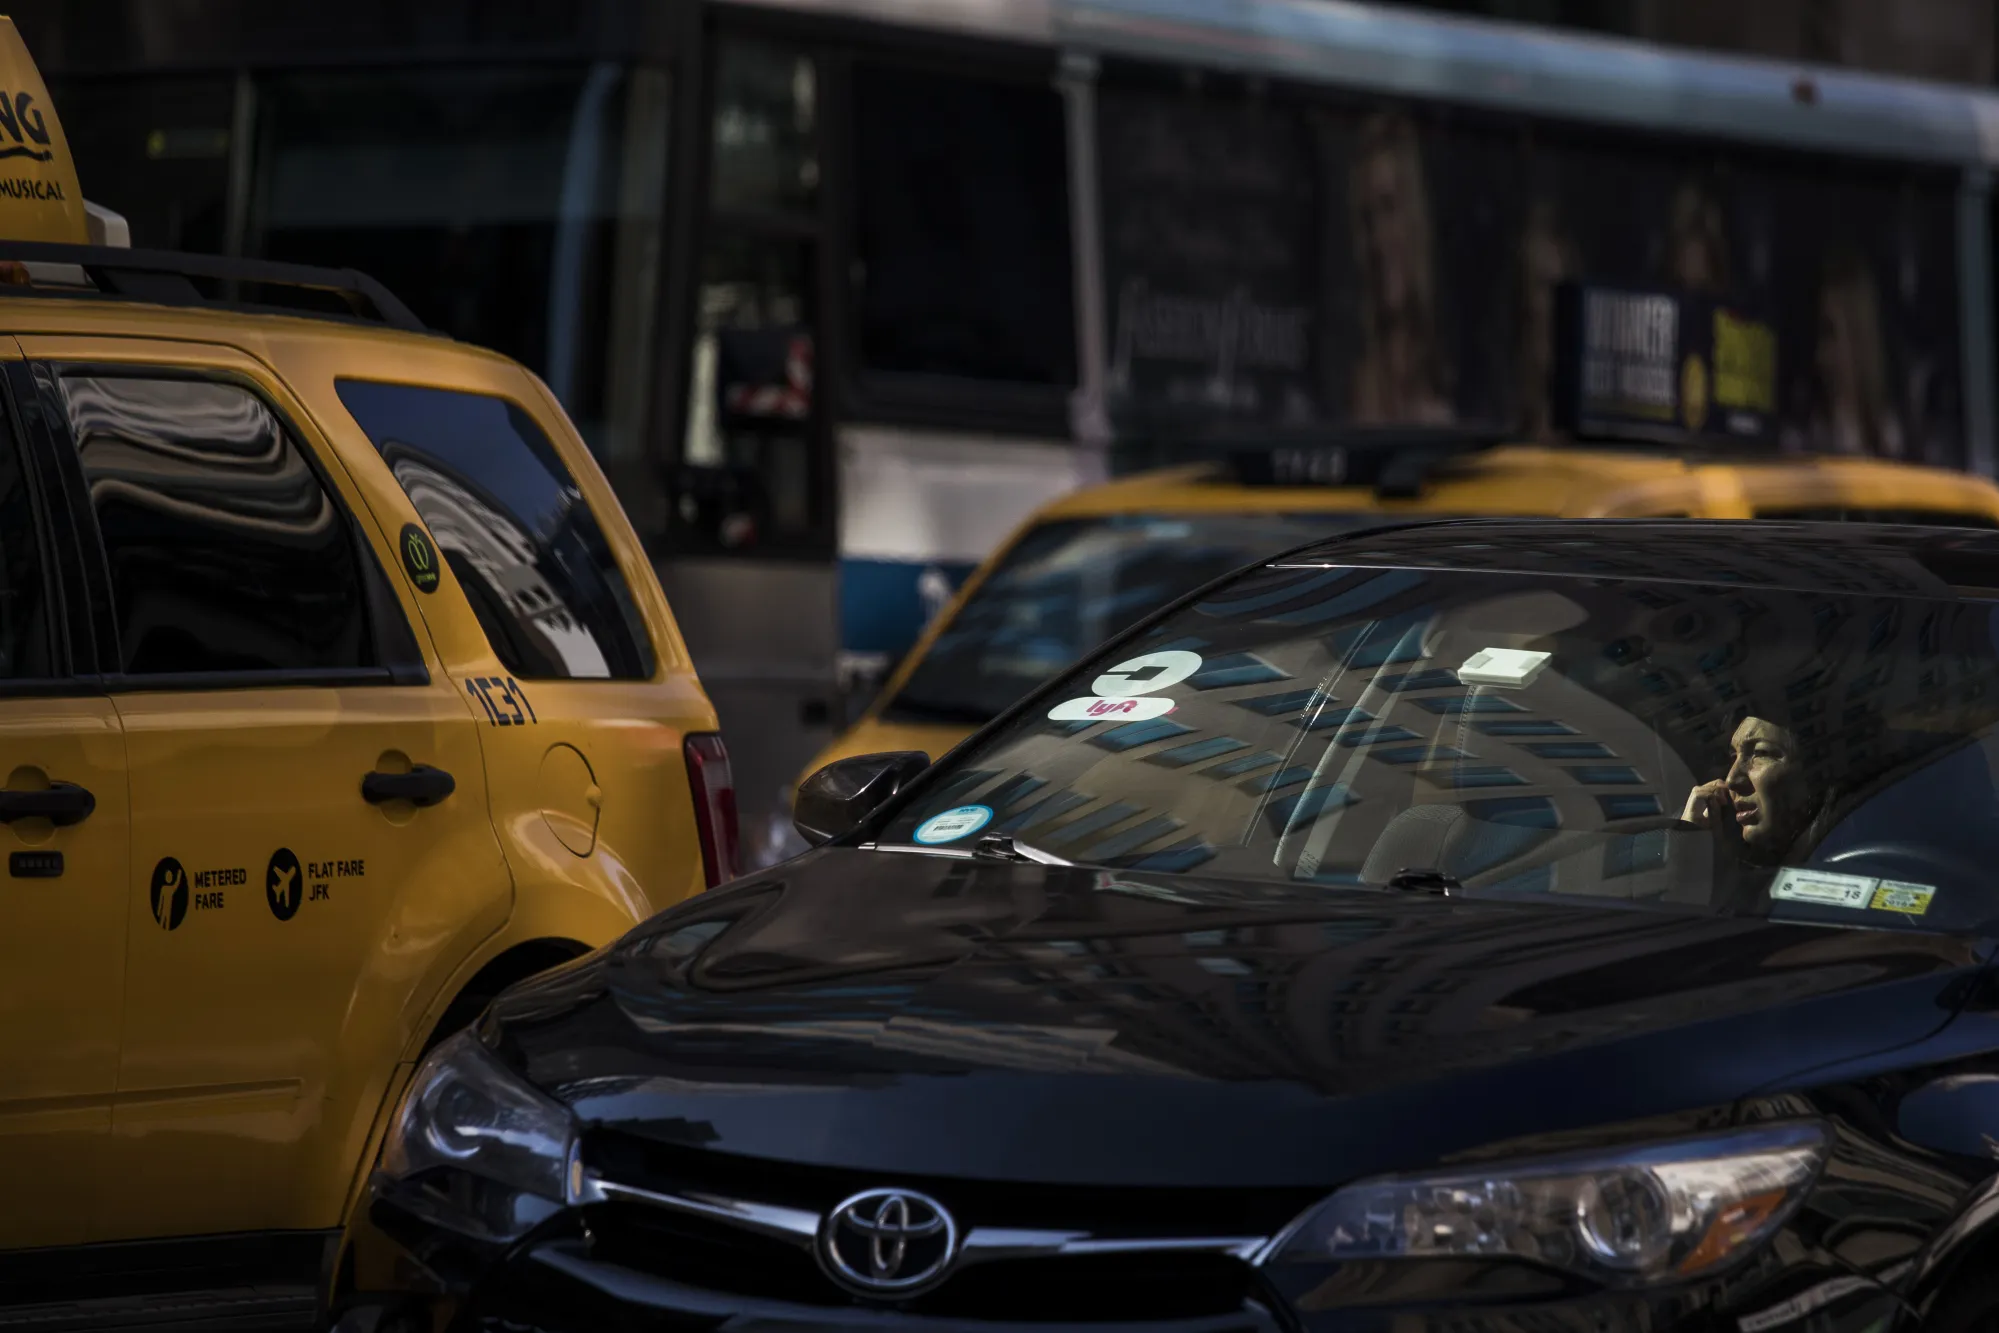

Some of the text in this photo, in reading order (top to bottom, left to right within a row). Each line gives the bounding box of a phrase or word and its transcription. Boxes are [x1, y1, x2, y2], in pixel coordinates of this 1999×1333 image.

[0, 178, 65, 201] MUSICAL
[194, 868, 247, 888] METERED
[308, 860, 365, 879] FLAT FARE
[195, 892, 224, 910] FARE
[308, 884, 329, 901] JFK
